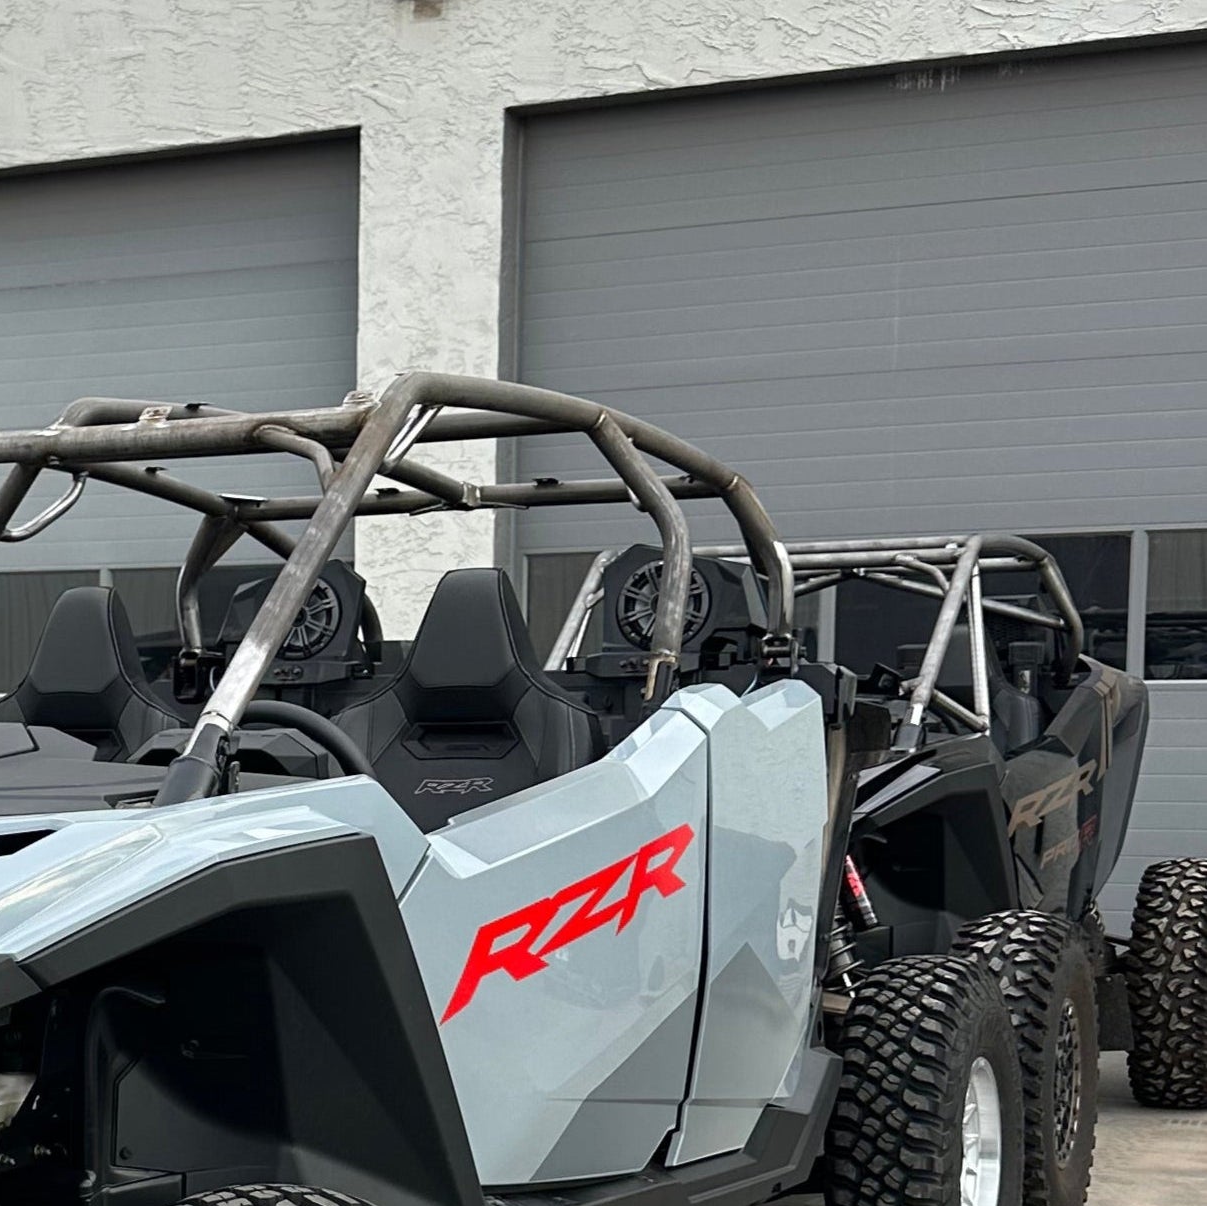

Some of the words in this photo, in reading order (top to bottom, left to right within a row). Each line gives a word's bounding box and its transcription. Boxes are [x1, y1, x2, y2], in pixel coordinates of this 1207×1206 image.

[413, 776, 496, 796] RZR
[1007, 758, 1098, 838] RZR
[440, 823, 695, 1026] RZR
